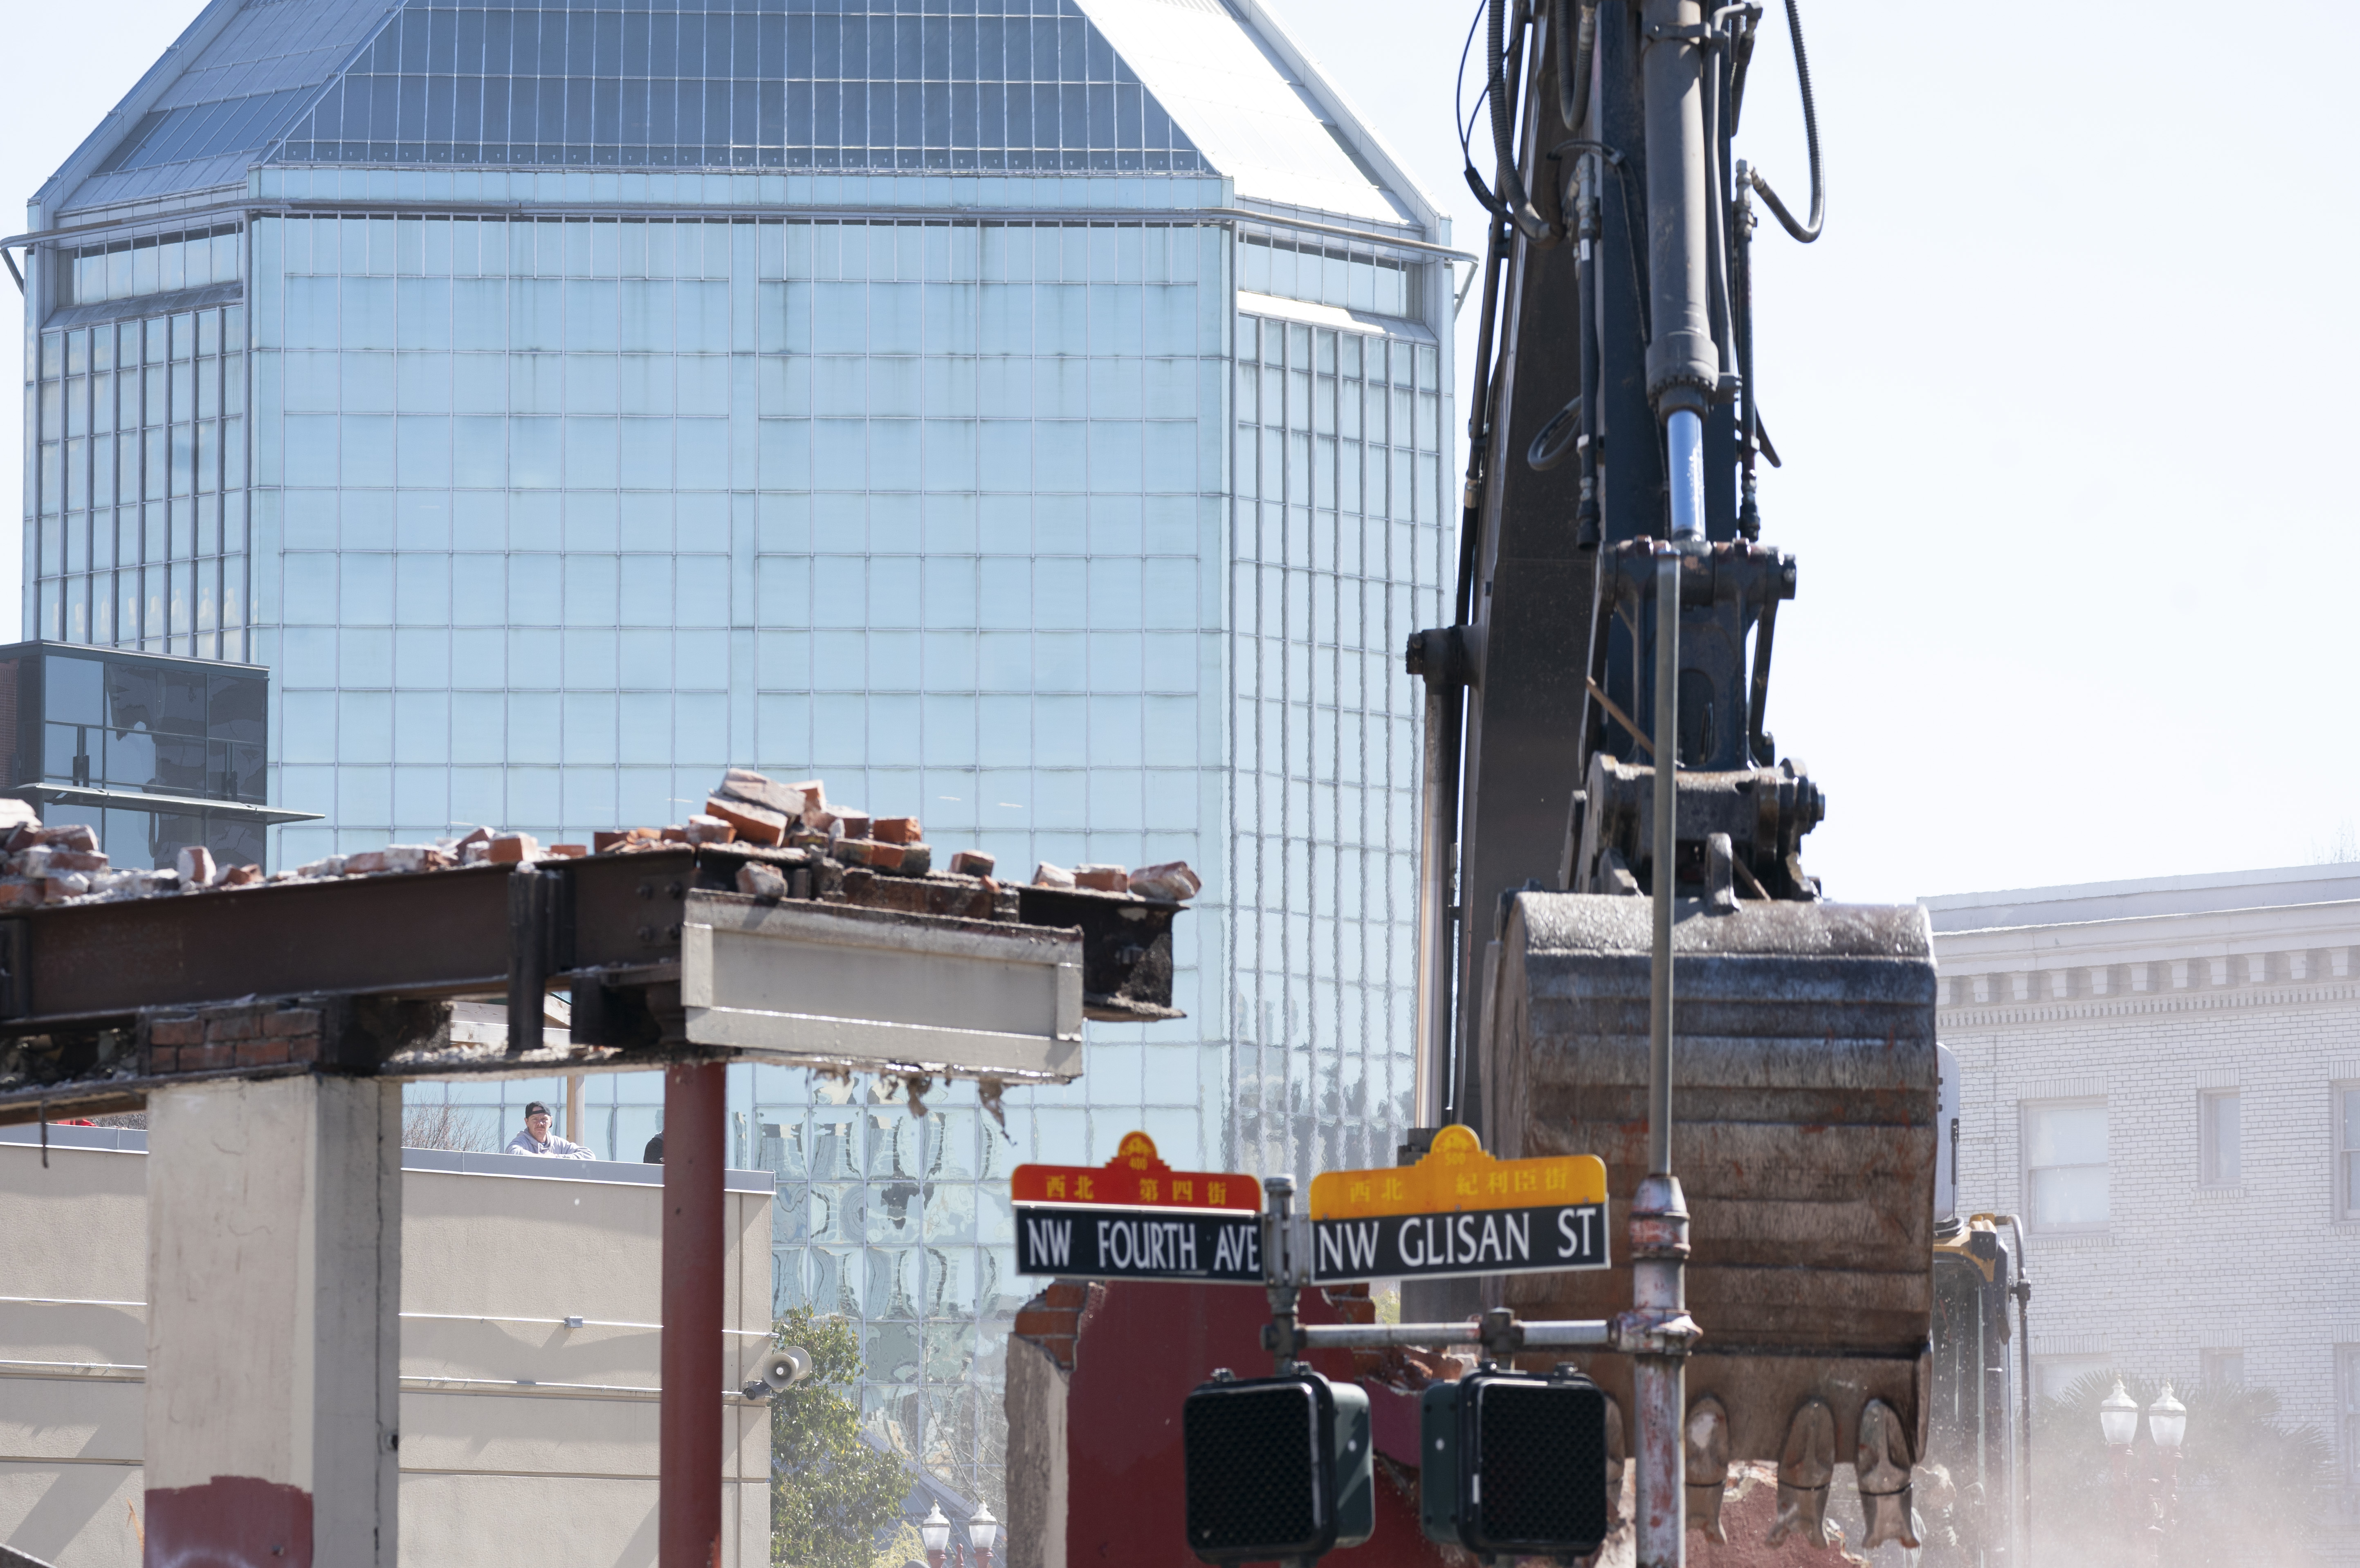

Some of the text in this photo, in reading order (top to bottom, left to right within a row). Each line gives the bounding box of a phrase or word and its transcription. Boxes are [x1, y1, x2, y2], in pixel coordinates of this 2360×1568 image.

[1046, 1174, 1227, 1206] 西北 第四街
[1350, 1178, 1403, 1203] 西北
[1026, 1218, 1261, 1272] NW FOURTH AVE
[1318, 1207, 1597, 1272] NW GLISAN ST
